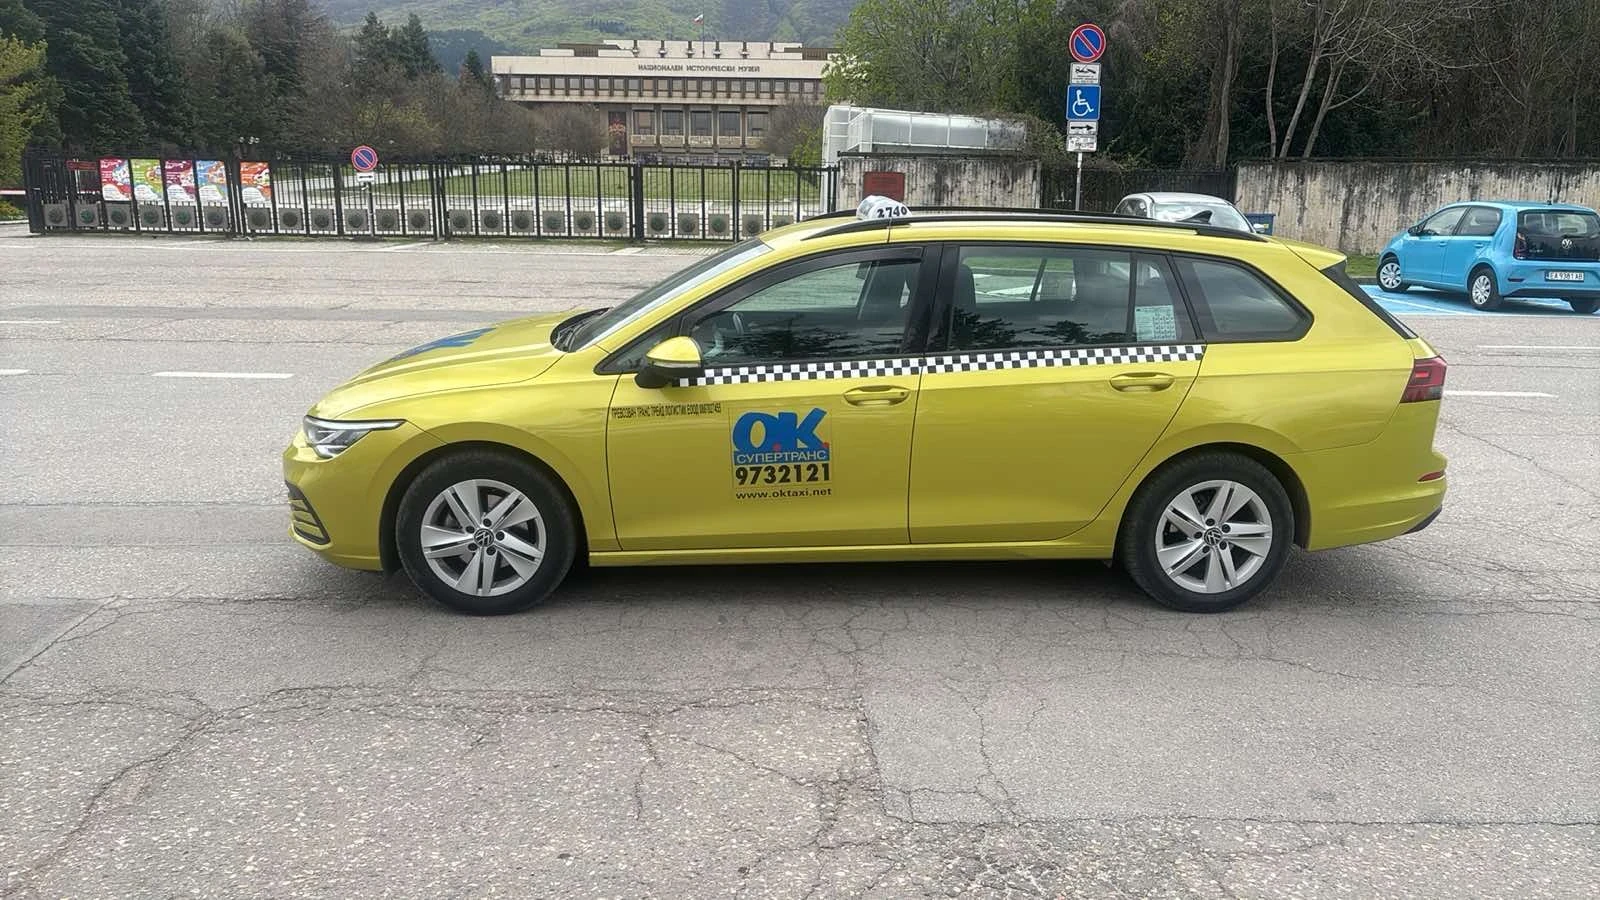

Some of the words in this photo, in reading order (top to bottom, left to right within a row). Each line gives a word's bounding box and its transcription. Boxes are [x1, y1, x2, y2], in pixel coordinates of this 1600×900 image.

[638, 64, 683, 72] НАЦИОНАЛЕН
[686, 65, 735, 73] ИСТОРИЧЕСКИ
[877, 206, 908, 218] 2740
[736, 450, 827, 464] СУПЕРТРАНС
[735, 463, 830, 486] 9732121
[736, 488, 832, 499] www.oktaxi.net
